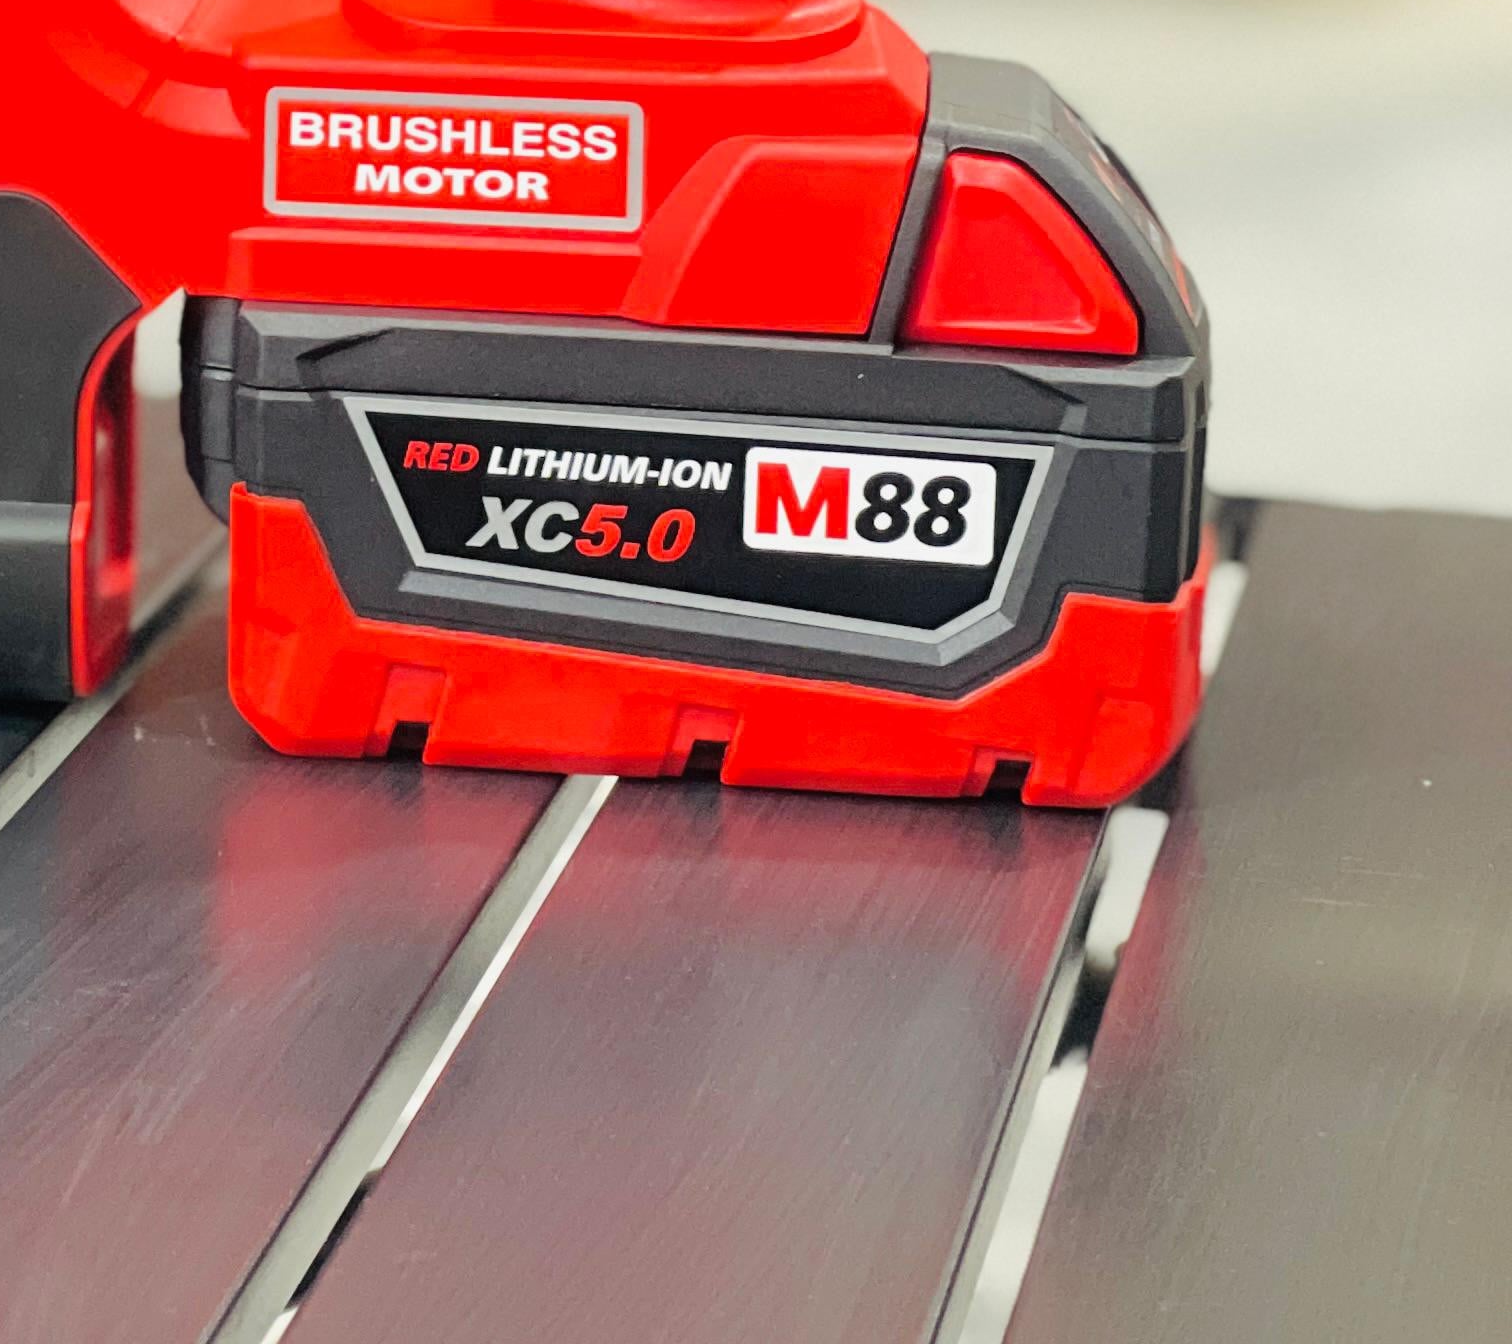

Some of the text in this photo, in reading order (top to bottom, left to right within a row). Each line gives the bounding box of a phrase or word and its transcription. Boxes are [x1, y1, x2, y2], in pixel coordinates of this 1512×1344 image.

[289, 111, 617, 161] BRUSHLESS
[354, 163, 550, 201] MOTOR
[403, 440, 733, 491] RED LITHIUM-ION
[465, 495, 697, 563] XC5.0
[754, 461, 972, 548] M88
